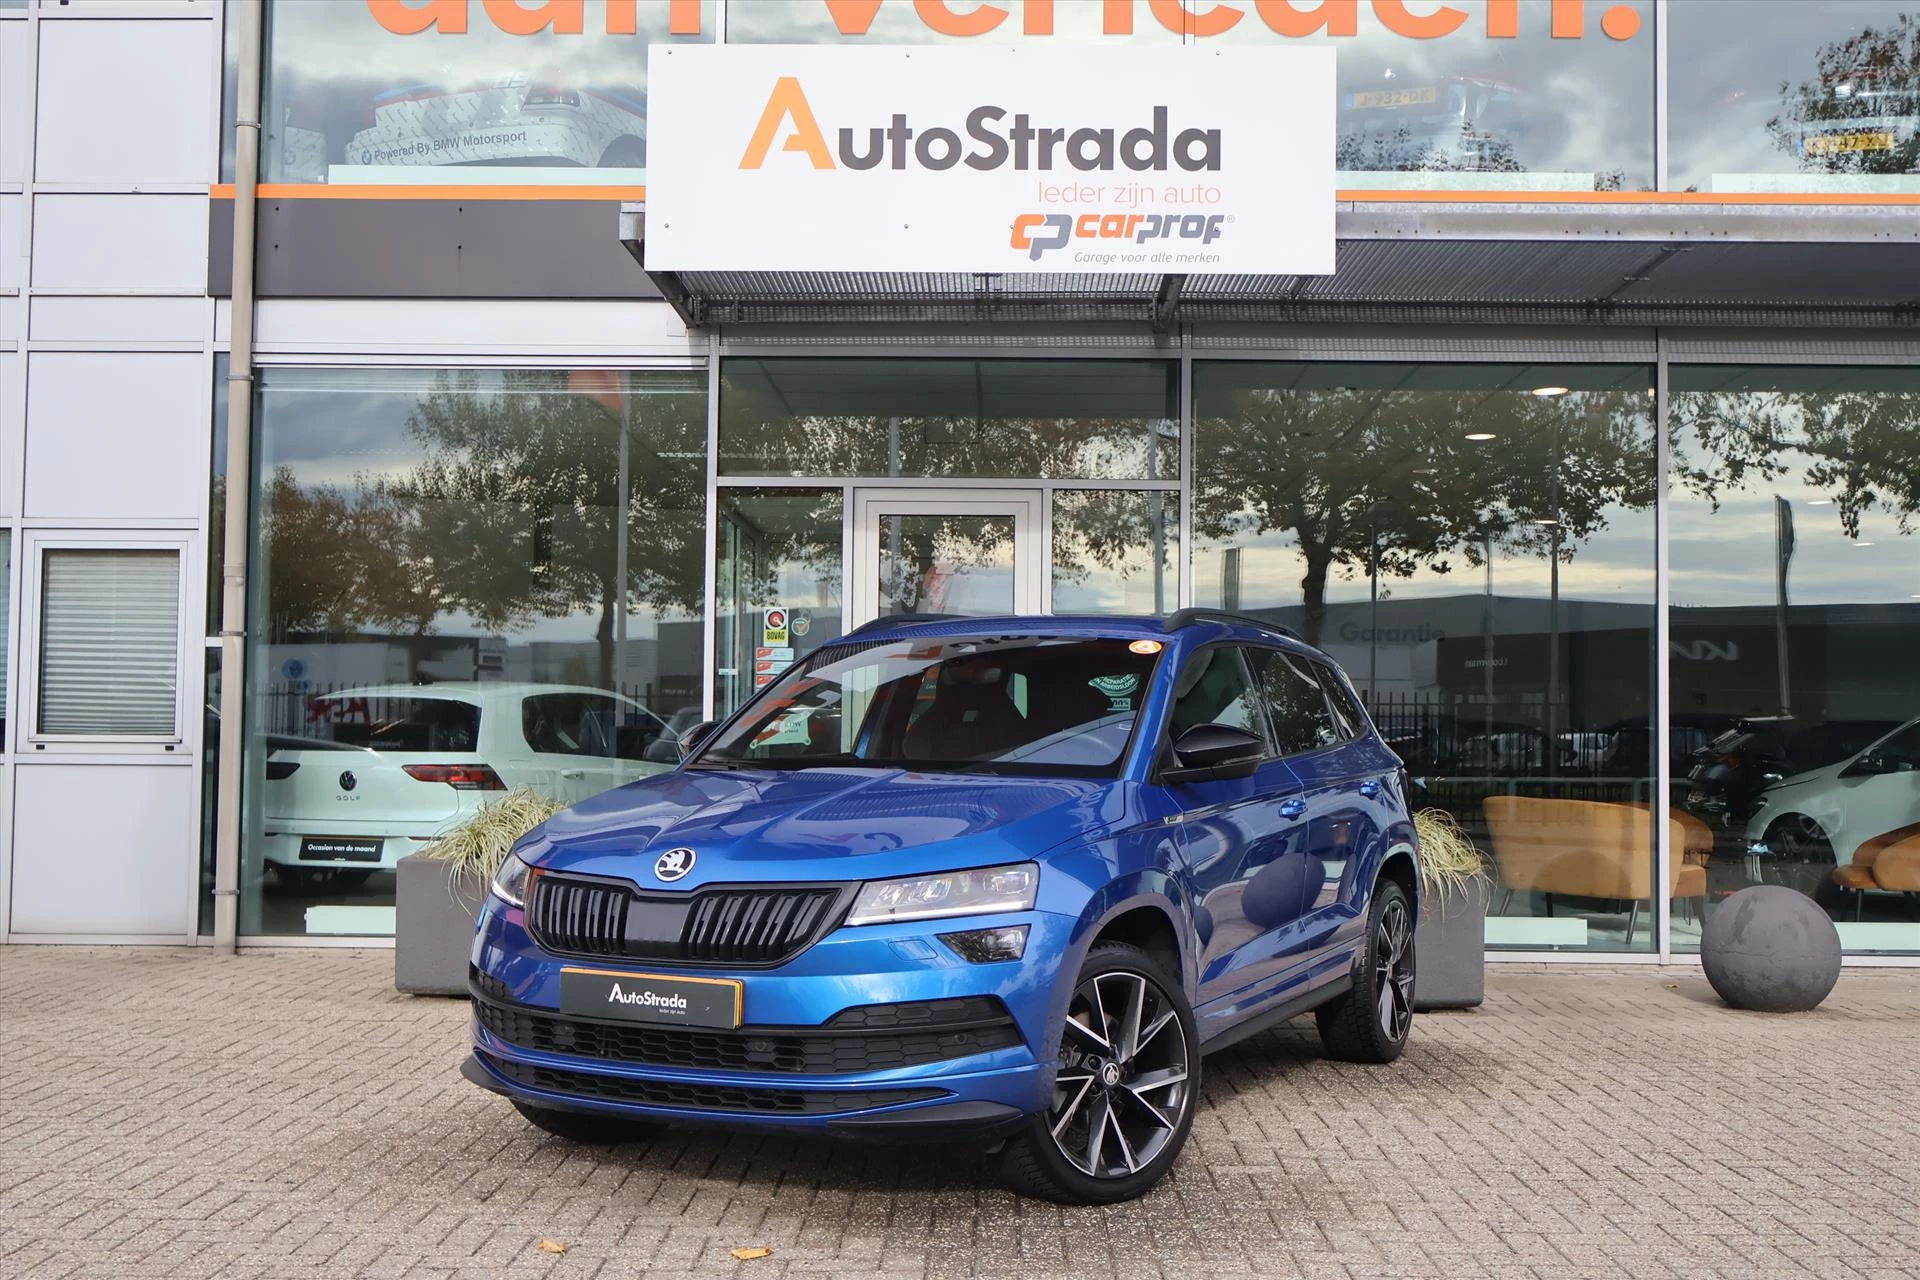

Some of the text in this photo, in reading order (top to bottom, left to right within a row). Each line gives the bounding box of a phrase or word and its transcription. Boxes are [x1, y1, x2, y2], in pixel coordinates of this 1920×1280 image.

[738, 76, 1221, 171] AutoStrada
[374, 130, 527, 162] Powered By BMW Motorsport
[1039, 181, 1221, 208] Ieder zijn auto
[1074, 251, 1220, 265] Garage voor alle merken
[766, 631, 785, 641] BOVAG
[608, 983, 687, 1008] AutoStrada
